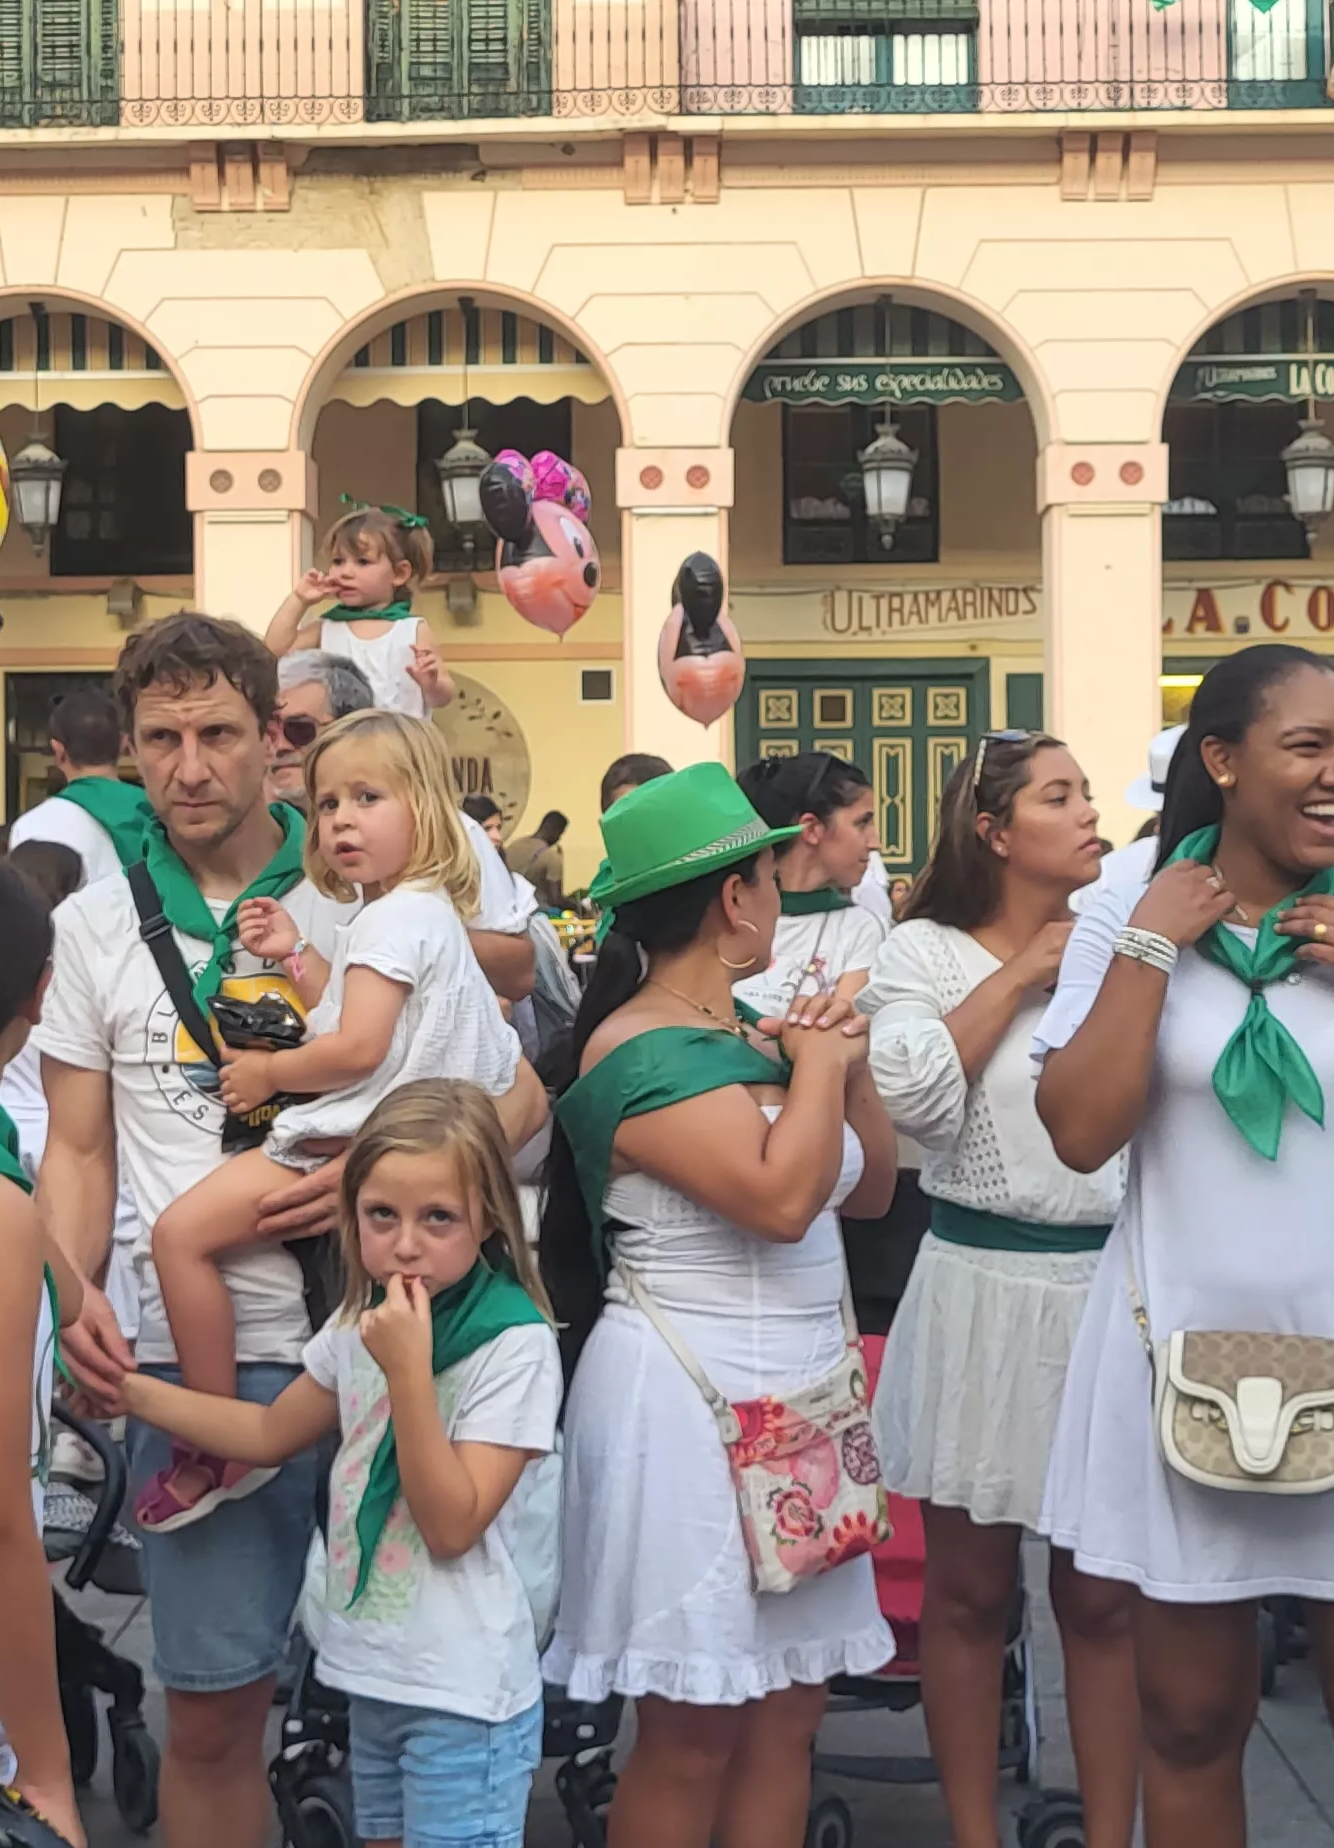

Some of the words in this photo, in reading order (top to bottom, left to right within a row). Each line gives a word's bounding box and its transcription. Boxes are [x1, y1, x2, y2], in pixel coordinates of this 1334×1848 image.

[835, 371, 869, 392] sus
[874, 366, 1005, 399] especialidades
[1289, 363, 1313, 395] LA
[830, 586, 1038, 634] ULTRAMARINOS
[1162, 587, 1225, 633] A
